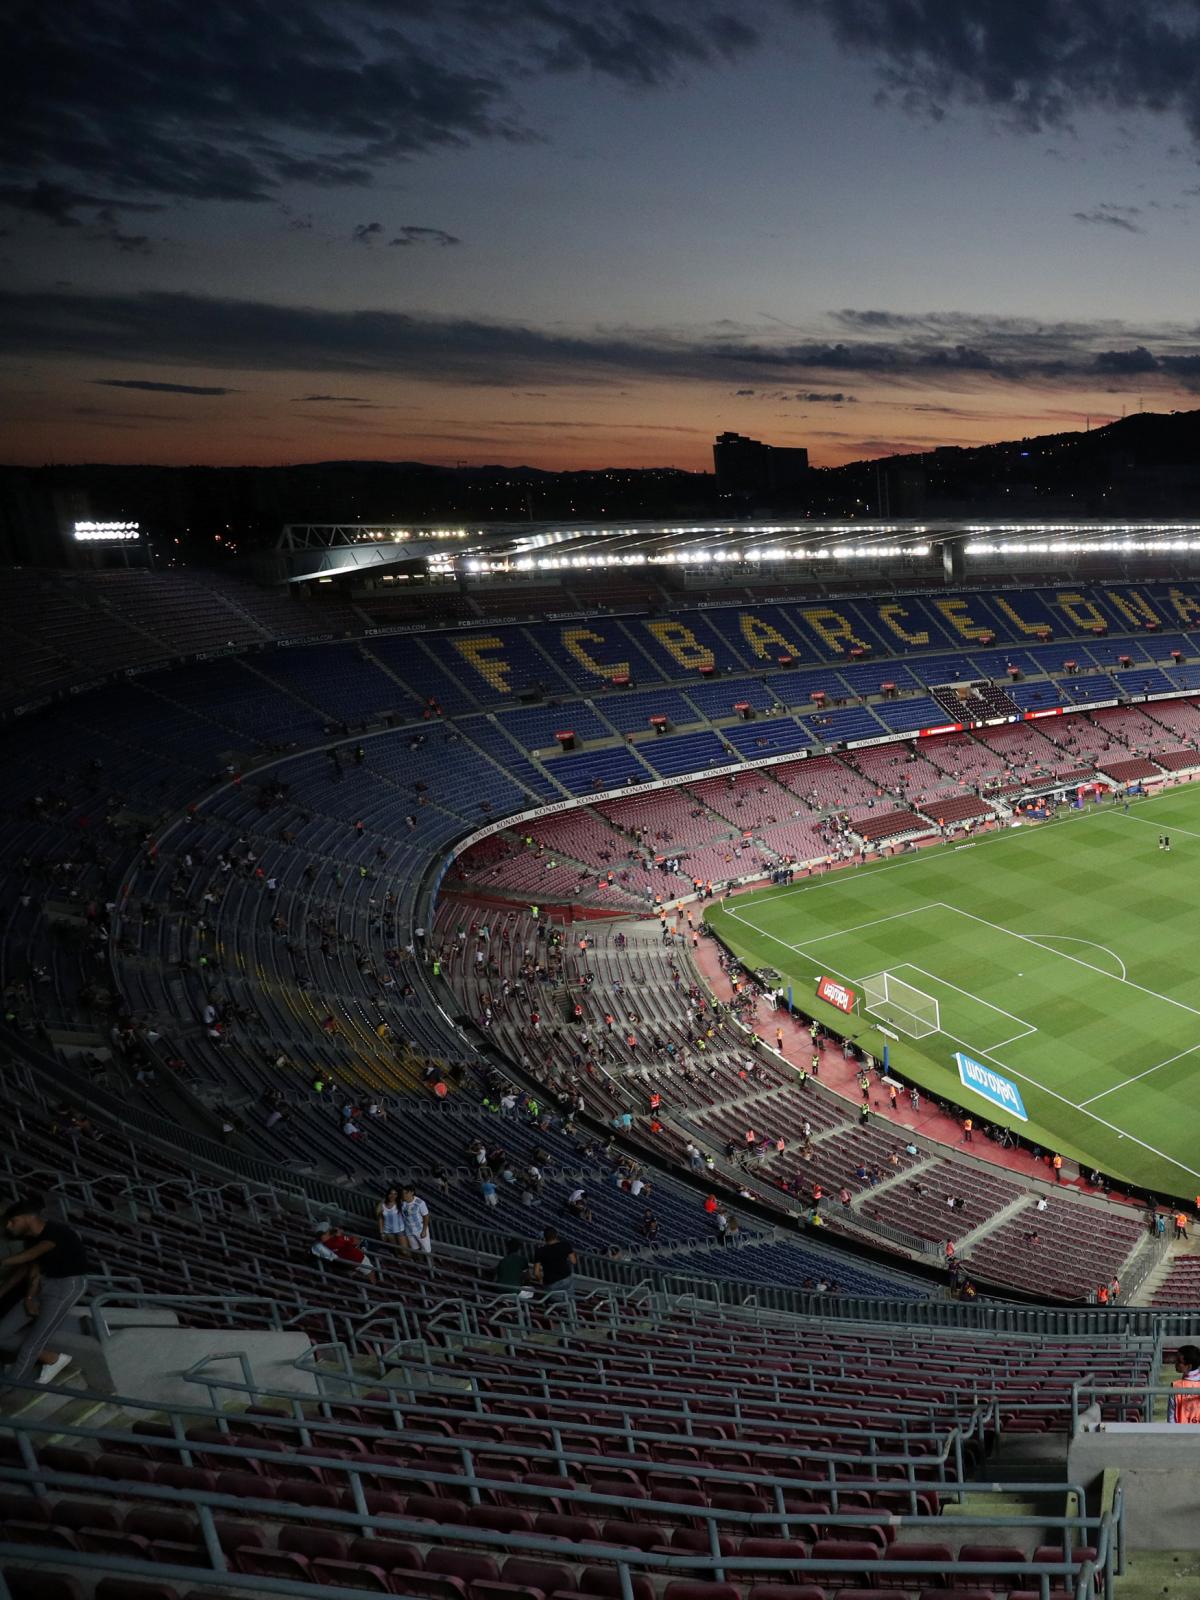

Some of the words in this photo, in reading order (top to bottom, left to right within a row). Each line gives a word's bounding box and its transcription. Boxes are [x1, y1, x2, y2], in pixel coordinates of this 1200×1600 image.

[856, 738, 881, 748] KONAMI
[496, 814, 525, 829] KONAMI
[534, 802, 566, 816] KONAMI
[576, 793, 610, 806] KONAMI
[621, 783, 653, 796] KONAMI
[662, 774, 693, 787] KONAMI
[703, 767, 732, 779] KONAMI
[740, 759, 768, 770] KONAMI
[776, 752, 804, 763] KONAMI
[823, 983, 850, 1010] Rakuten
[964, 1059, 1020, 1110] beko.com
